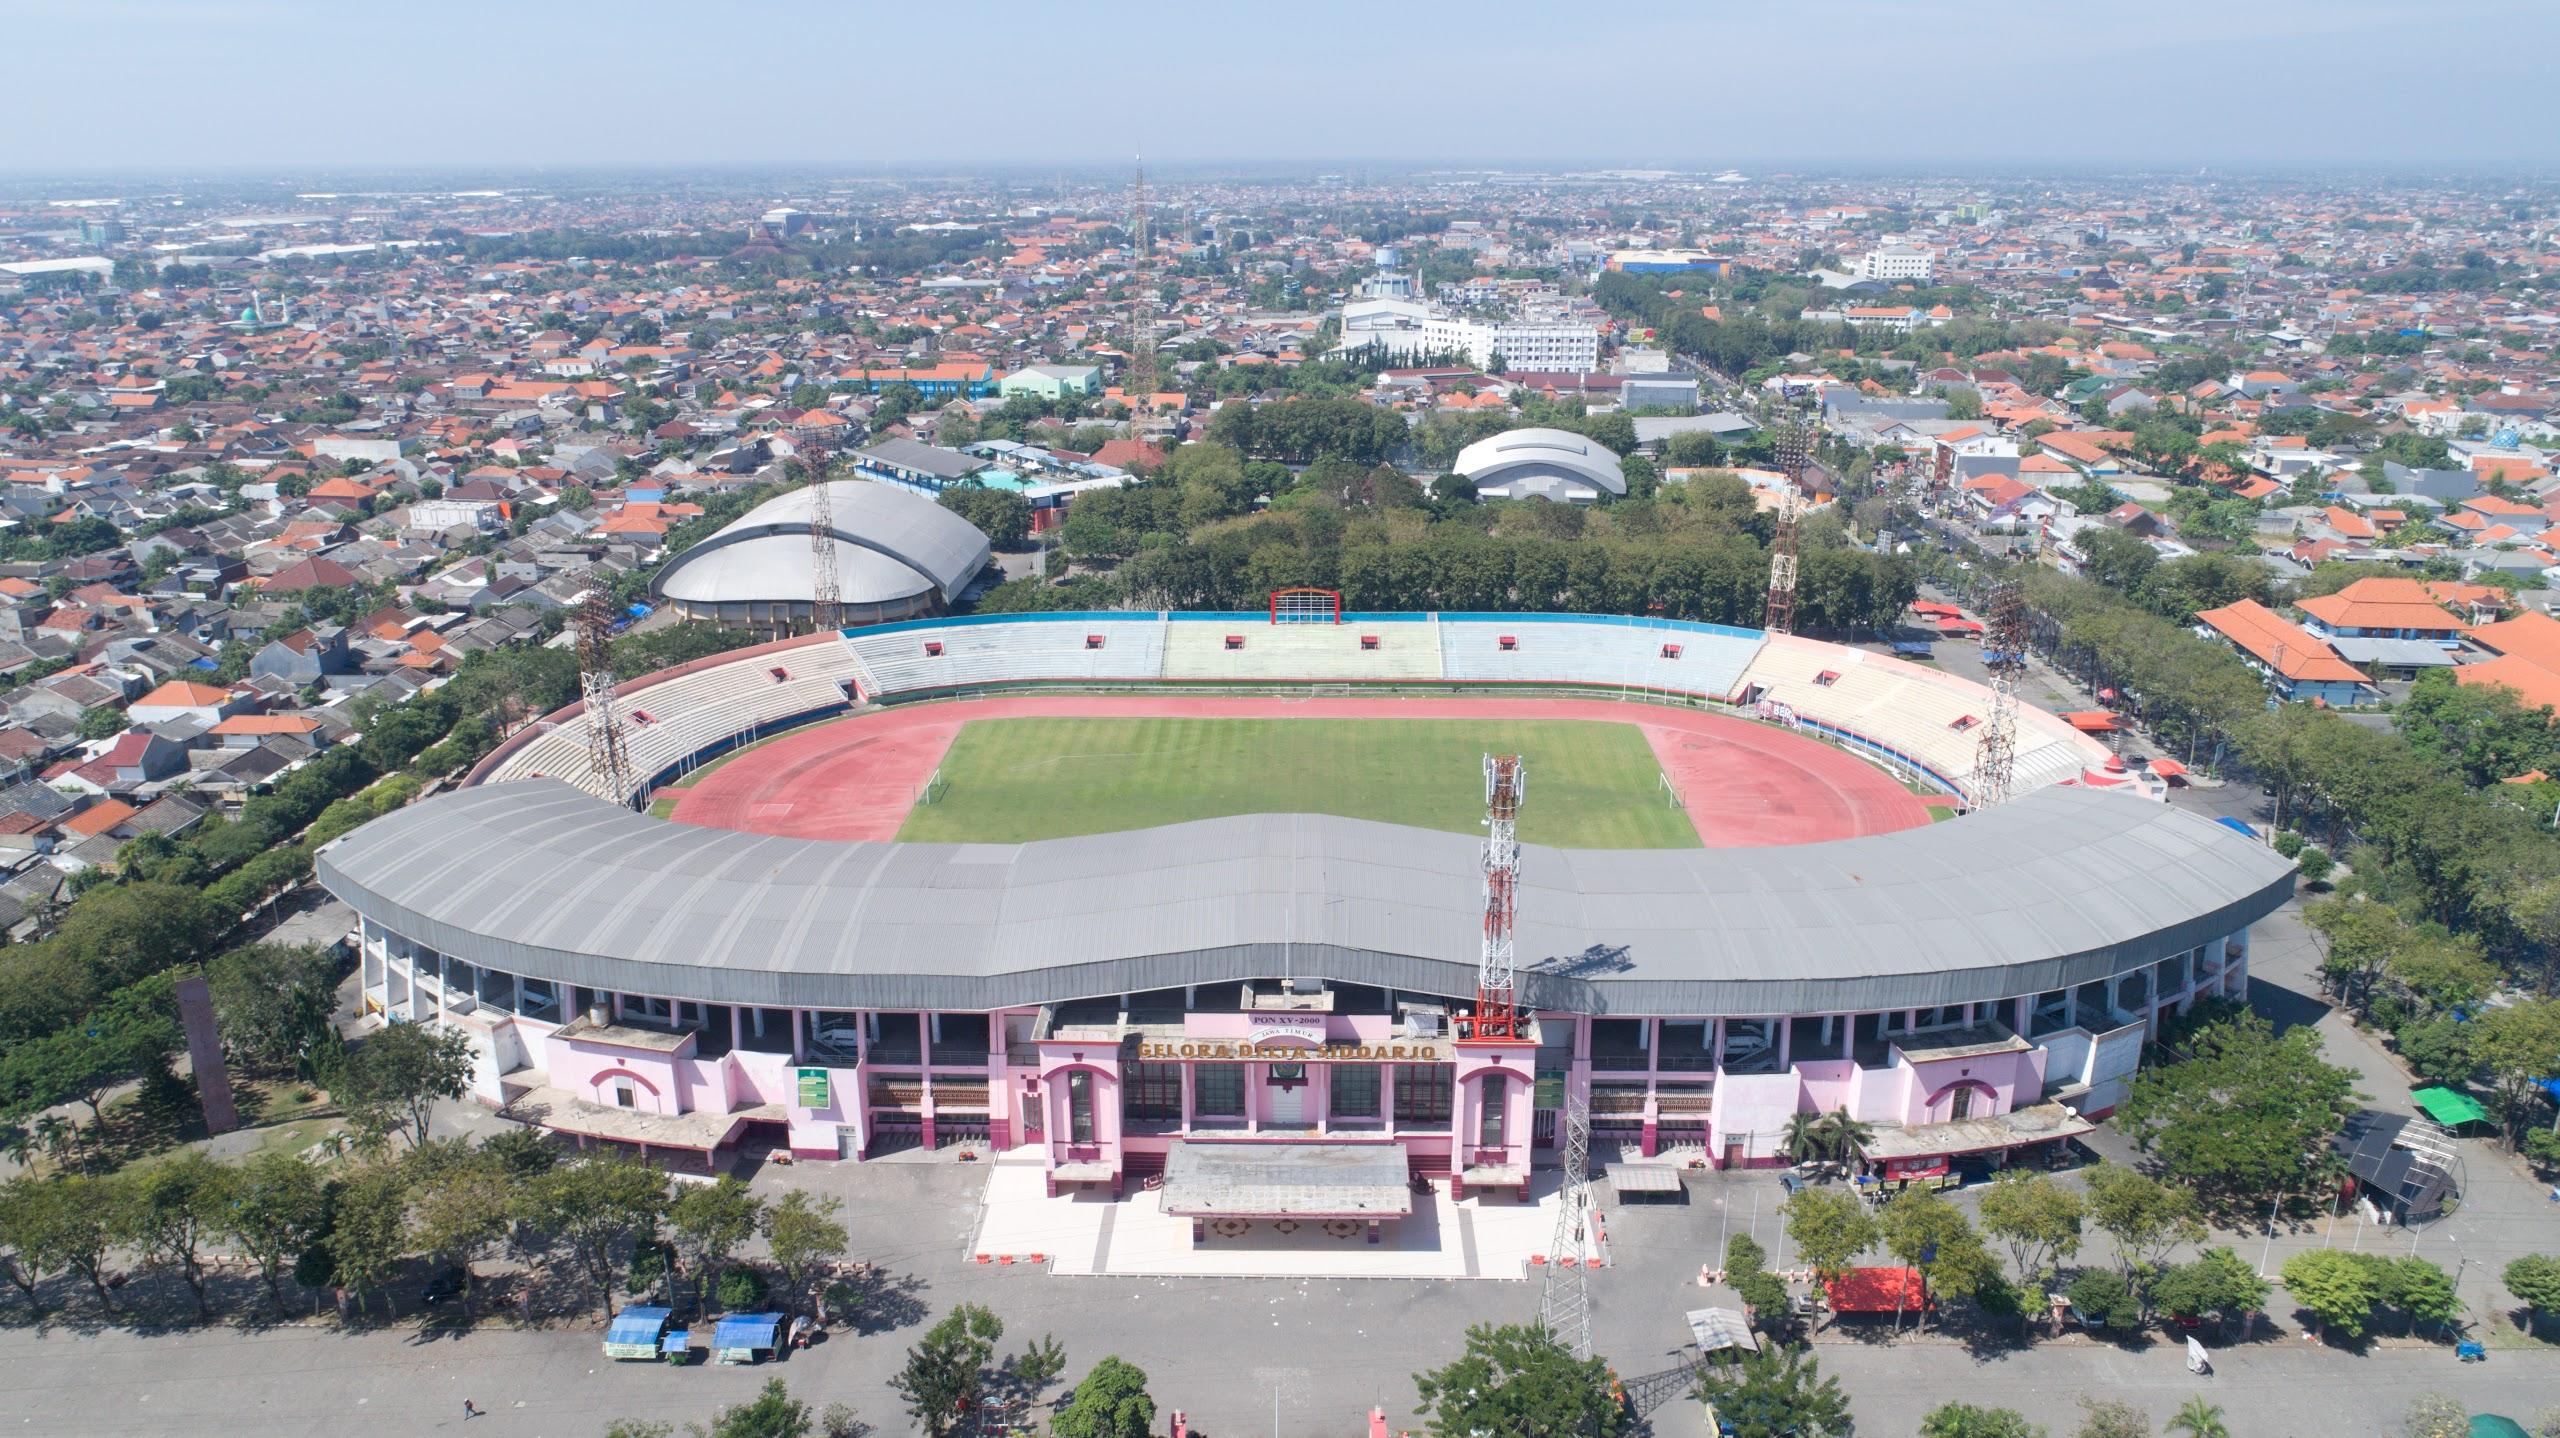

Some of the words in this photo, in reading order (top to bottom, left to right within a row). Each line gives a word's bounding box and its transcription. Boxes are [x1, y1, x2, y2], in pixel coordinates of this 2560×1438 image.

[1254, 1016, 1276, 1024] PON
[1262, 1029, 1281, 1037] JAWA
[1285, 1028, 1314, 1038] TIMUR
[1138, 1043, 1230, 1058] GELORA
[1239, 1044, 1308, 1059] DELTA
[1317, 1045, 1436, 1059] SIDOARJO
